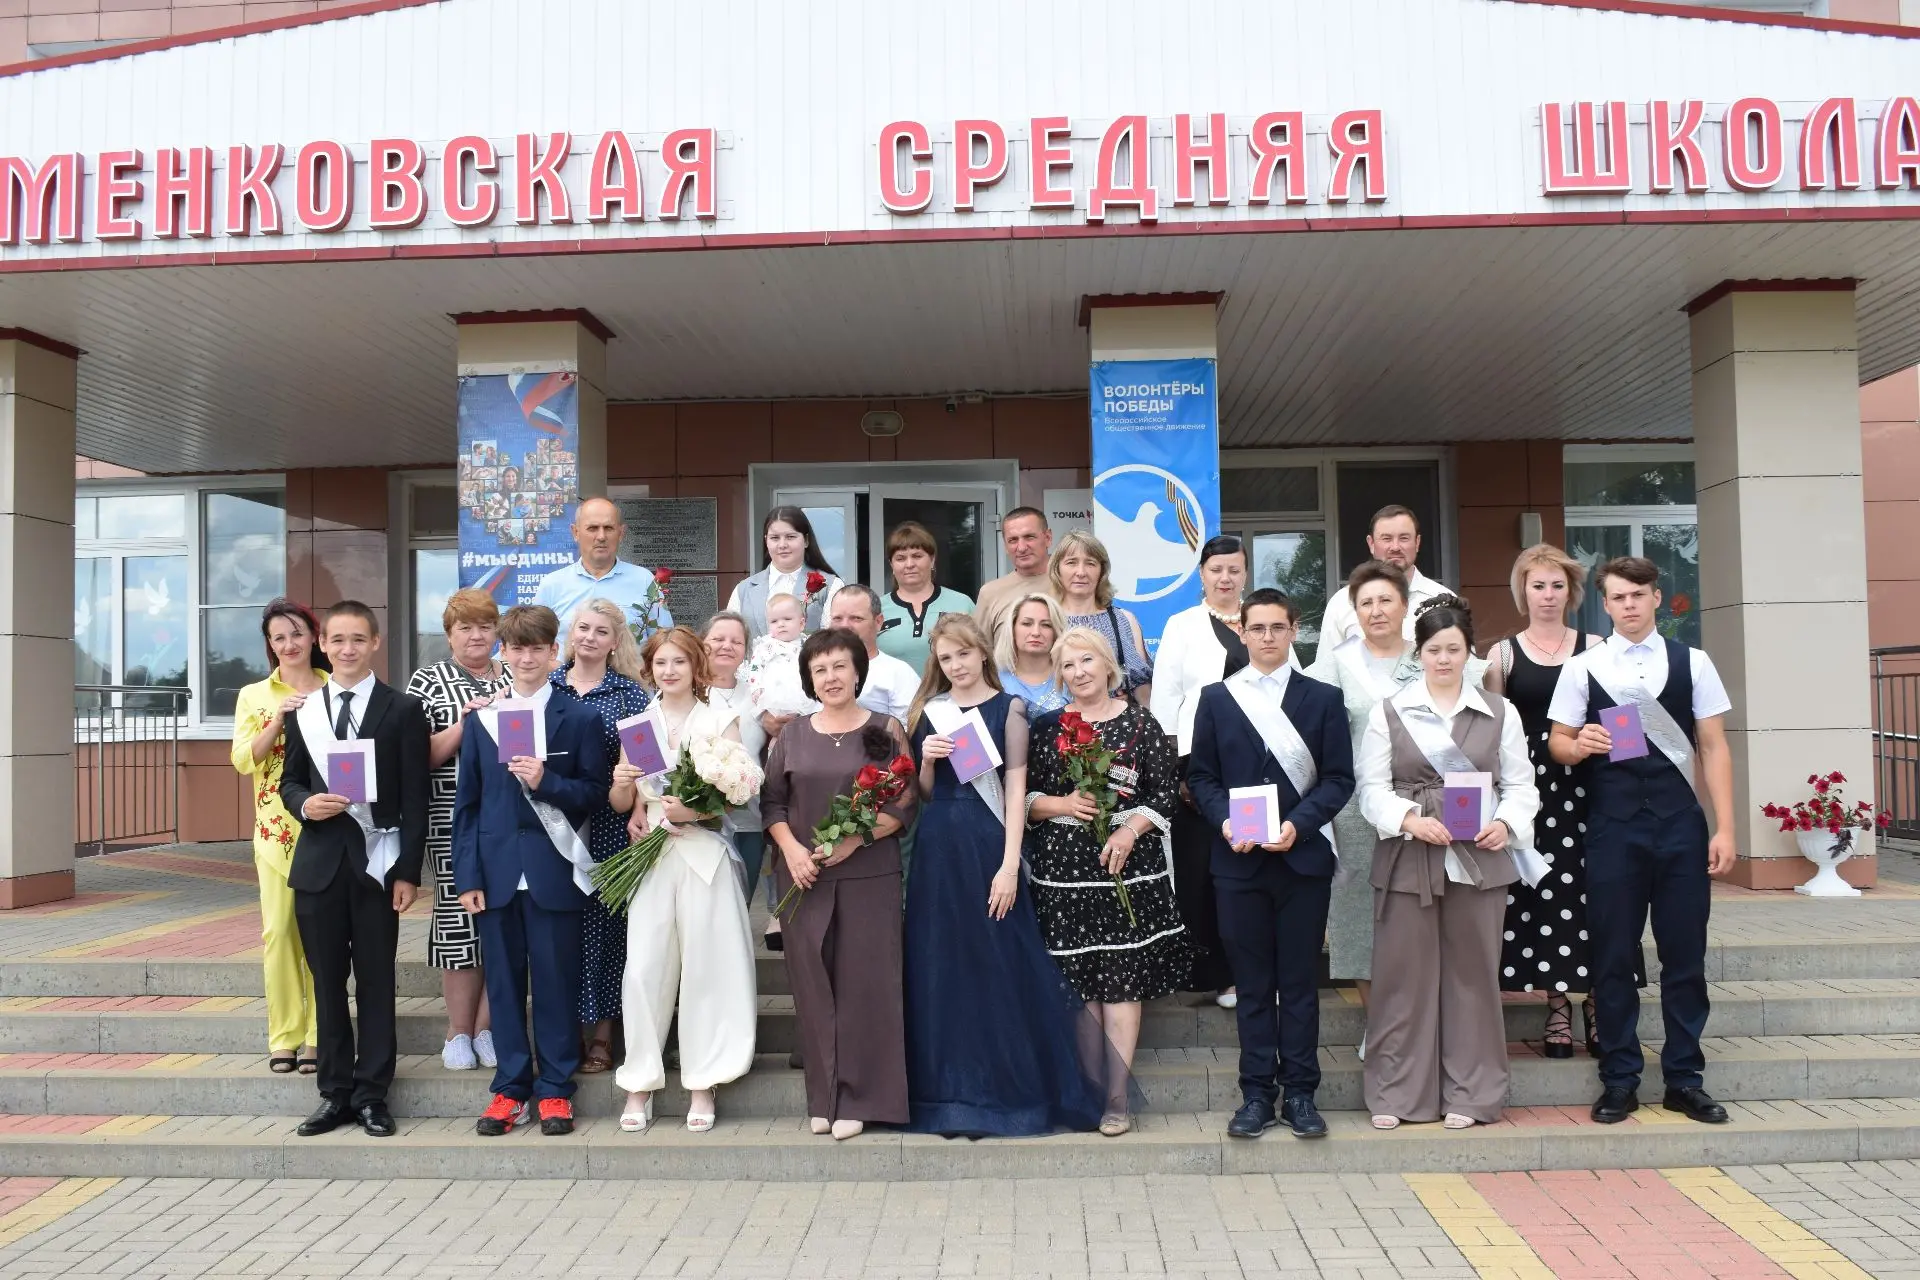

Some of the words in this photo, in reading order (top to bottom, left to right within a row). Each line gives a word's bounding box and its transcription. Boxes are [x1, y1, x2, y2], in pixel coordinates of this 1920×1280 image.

[0, 126, 719, 247] МЕНКОВСКАЯ
[876, 108, 1389, 224] СРЕДНЯЯ
[1538, 96, 1920, 198] ШКОЛА
[1104, 381, 1204, 398] ВОЛОНТЁРЫ
[1104, 399, 1174, 414] ПОБЕДЫ
[1104, 416, 1167, 425] Всероссийское
[1104, 424, 1163, 432] общественное
[1052, 511, 1085, 519] ТОЧКА
